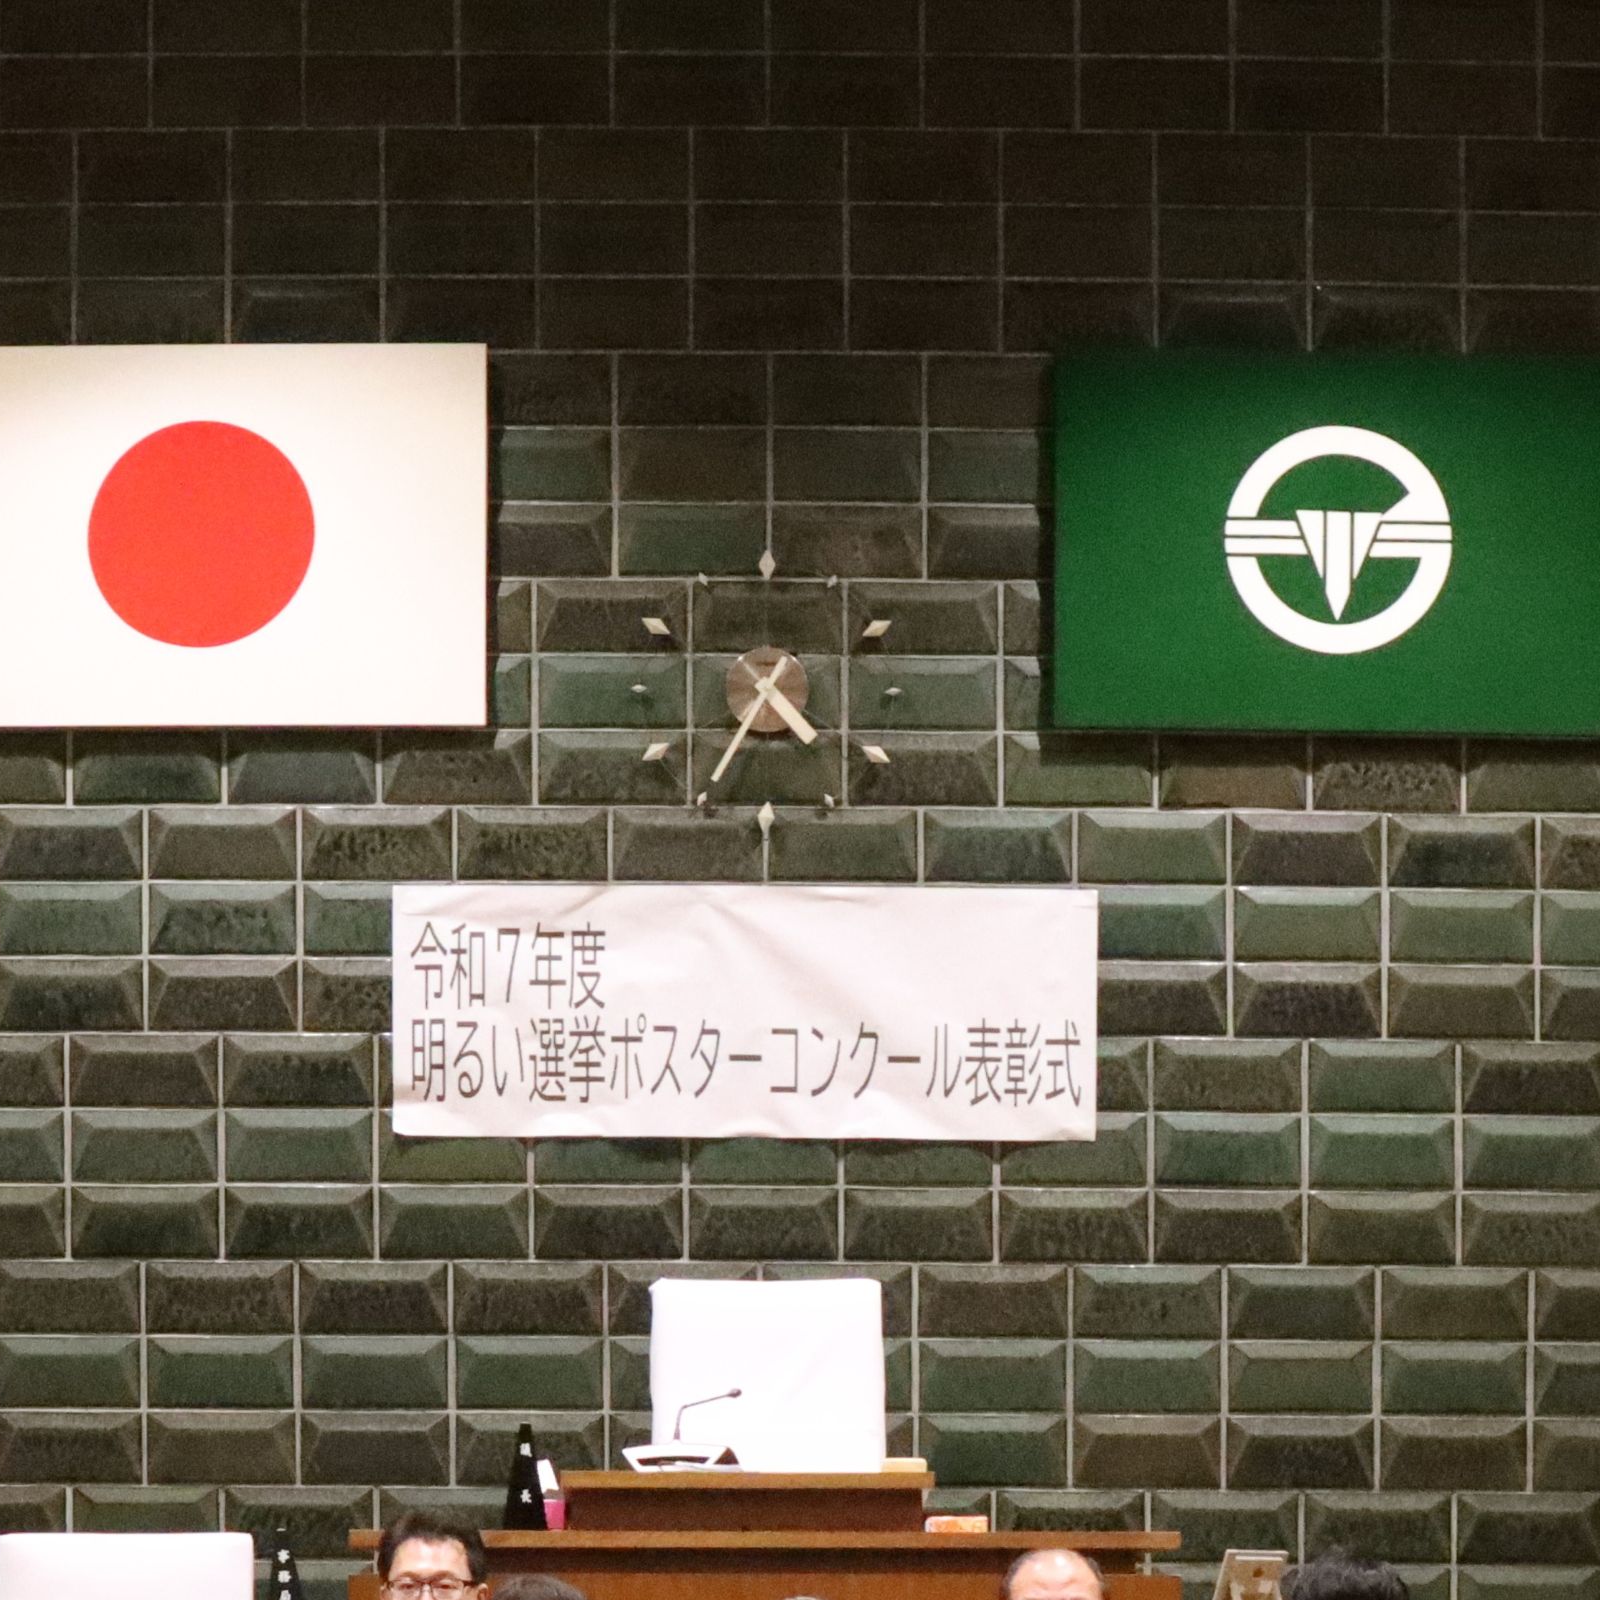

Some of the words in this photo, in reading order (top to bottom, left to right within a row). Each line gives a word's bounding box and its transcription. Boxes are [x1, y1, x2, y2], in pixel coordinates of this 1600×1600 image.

[409, 921, 607, 1009] 令和7年度
[409, 1012, 1082, 1108] 明るい選挙ポスターコンクール表彰式
